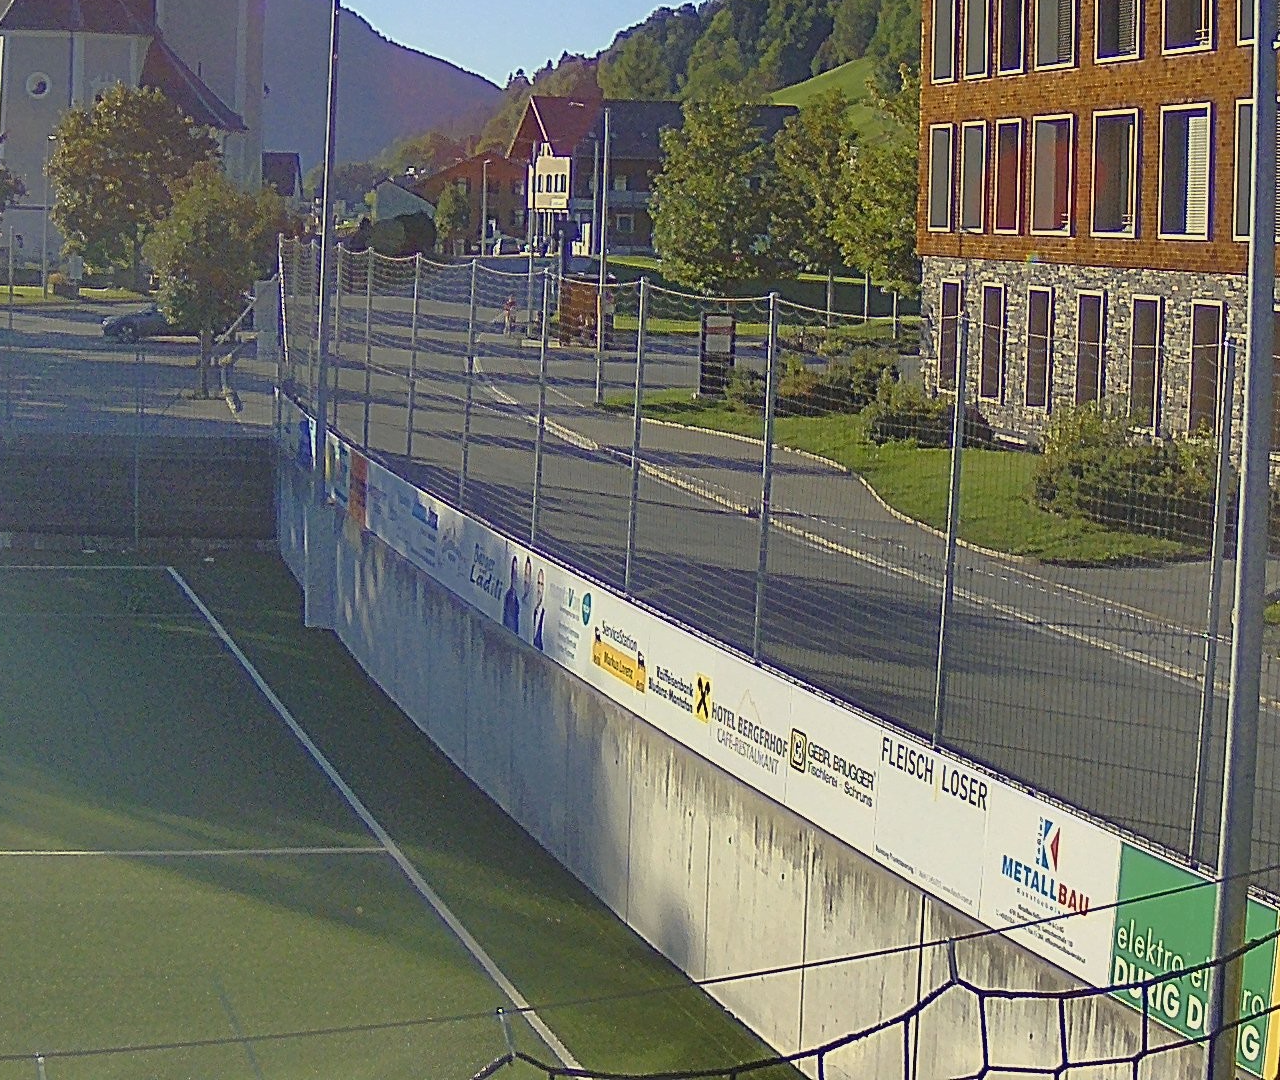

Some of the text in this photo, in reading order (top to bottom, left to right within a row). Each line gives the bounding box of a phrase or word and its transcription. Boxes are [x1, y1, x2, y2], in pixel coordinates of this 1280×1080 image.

[711, 701, 736, 731] HOTEL
[843, 780, 873, 808] Schruns
[881, 736, 988, 811] FLEISCH LOSER
[1117, 919, 1184, 973] elektro
